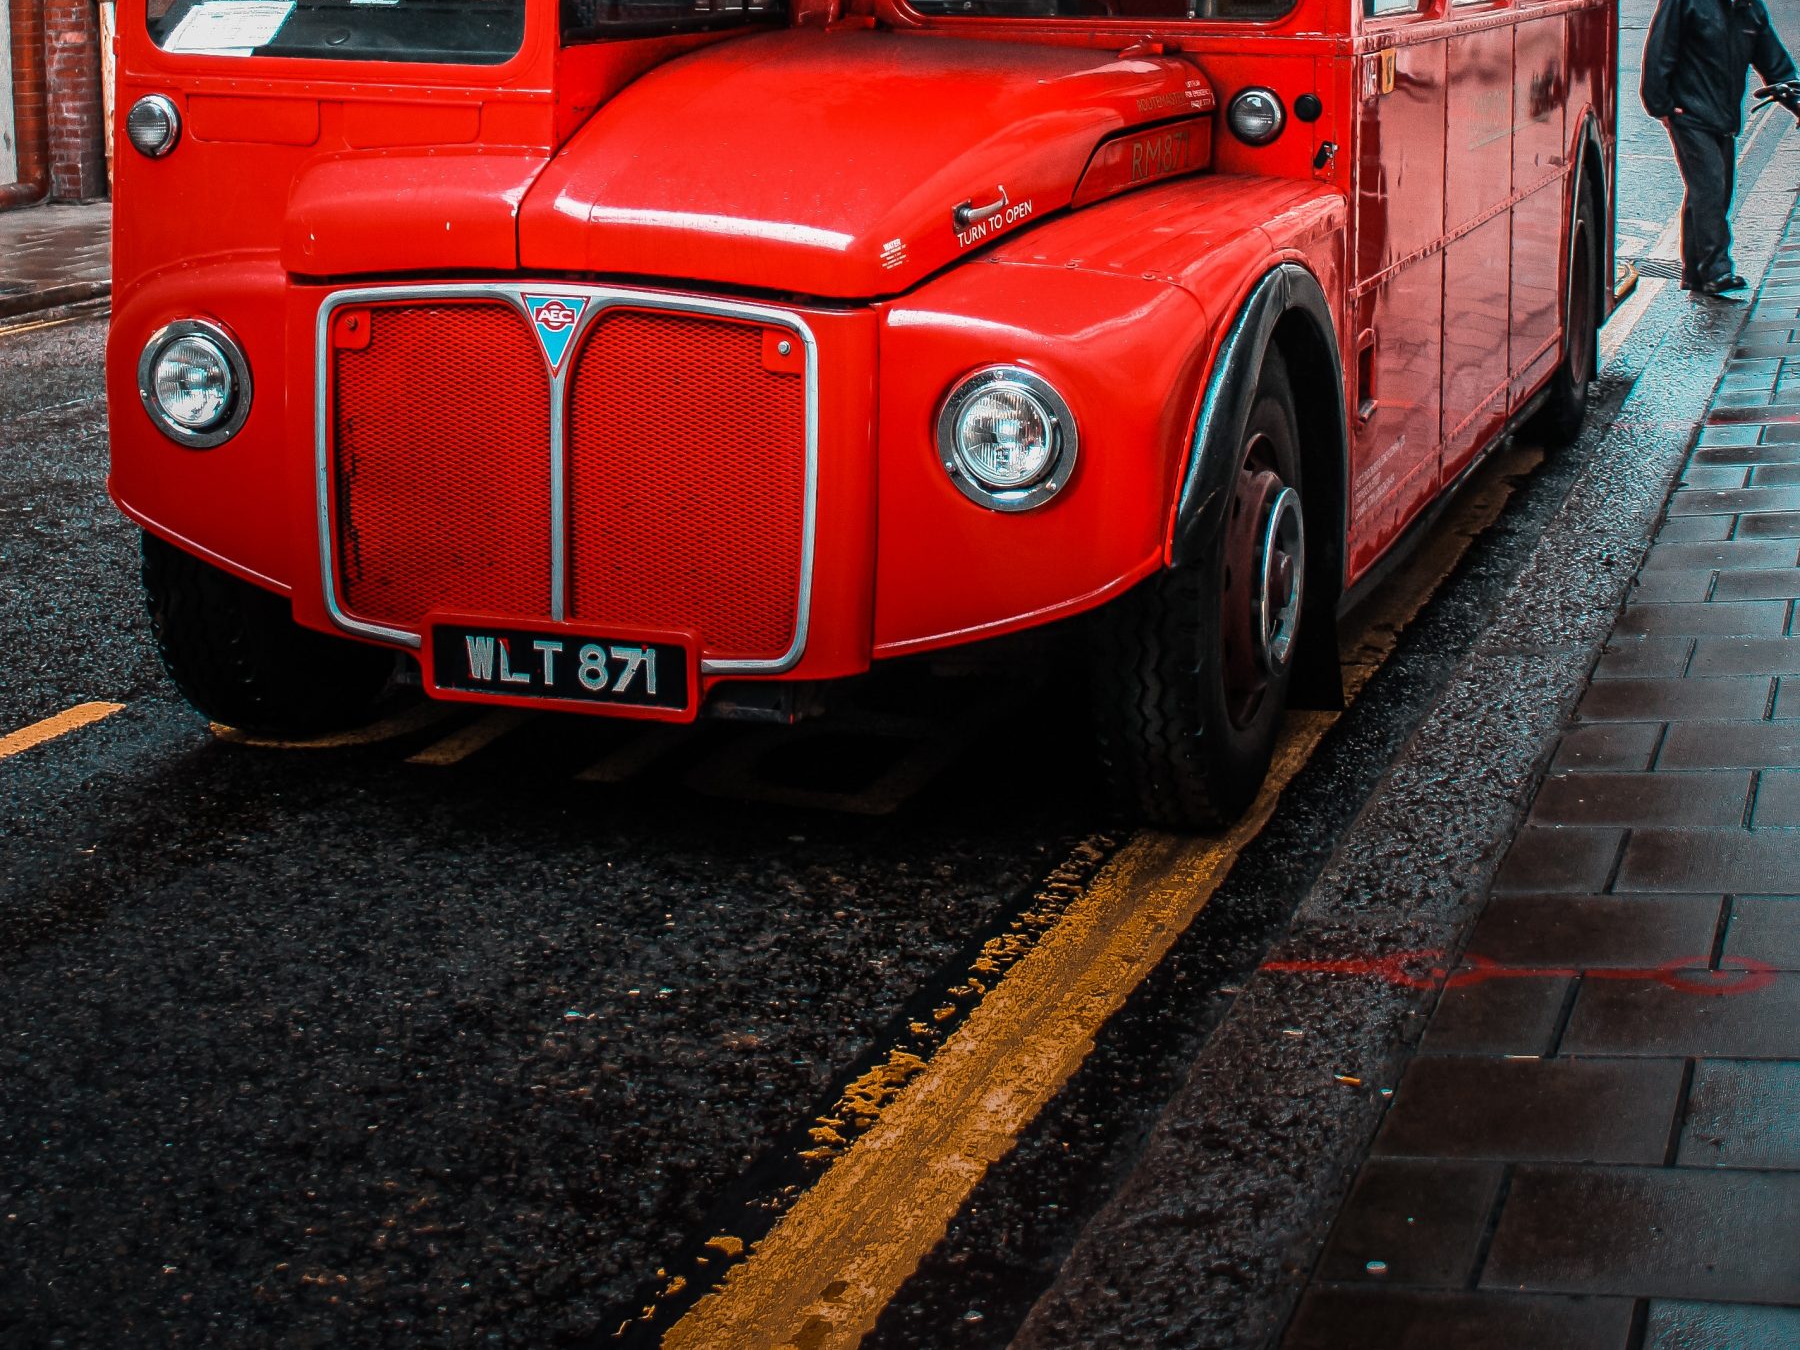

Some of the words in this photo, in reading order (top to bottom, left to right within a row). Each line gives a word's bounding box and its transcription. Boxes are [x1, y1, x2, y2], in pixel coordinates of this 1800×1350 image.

[1132, 130, 1189, 180] RM871
[957, 222, 986, 248] TURN
[988, 214, 1003, 231] TO
[1006, 199, 1032, 223] OPEN
[538, 309, 573, 322] AEC
[465, 635, 563, 685] WLT
[578, 644, 656, 694] 871
